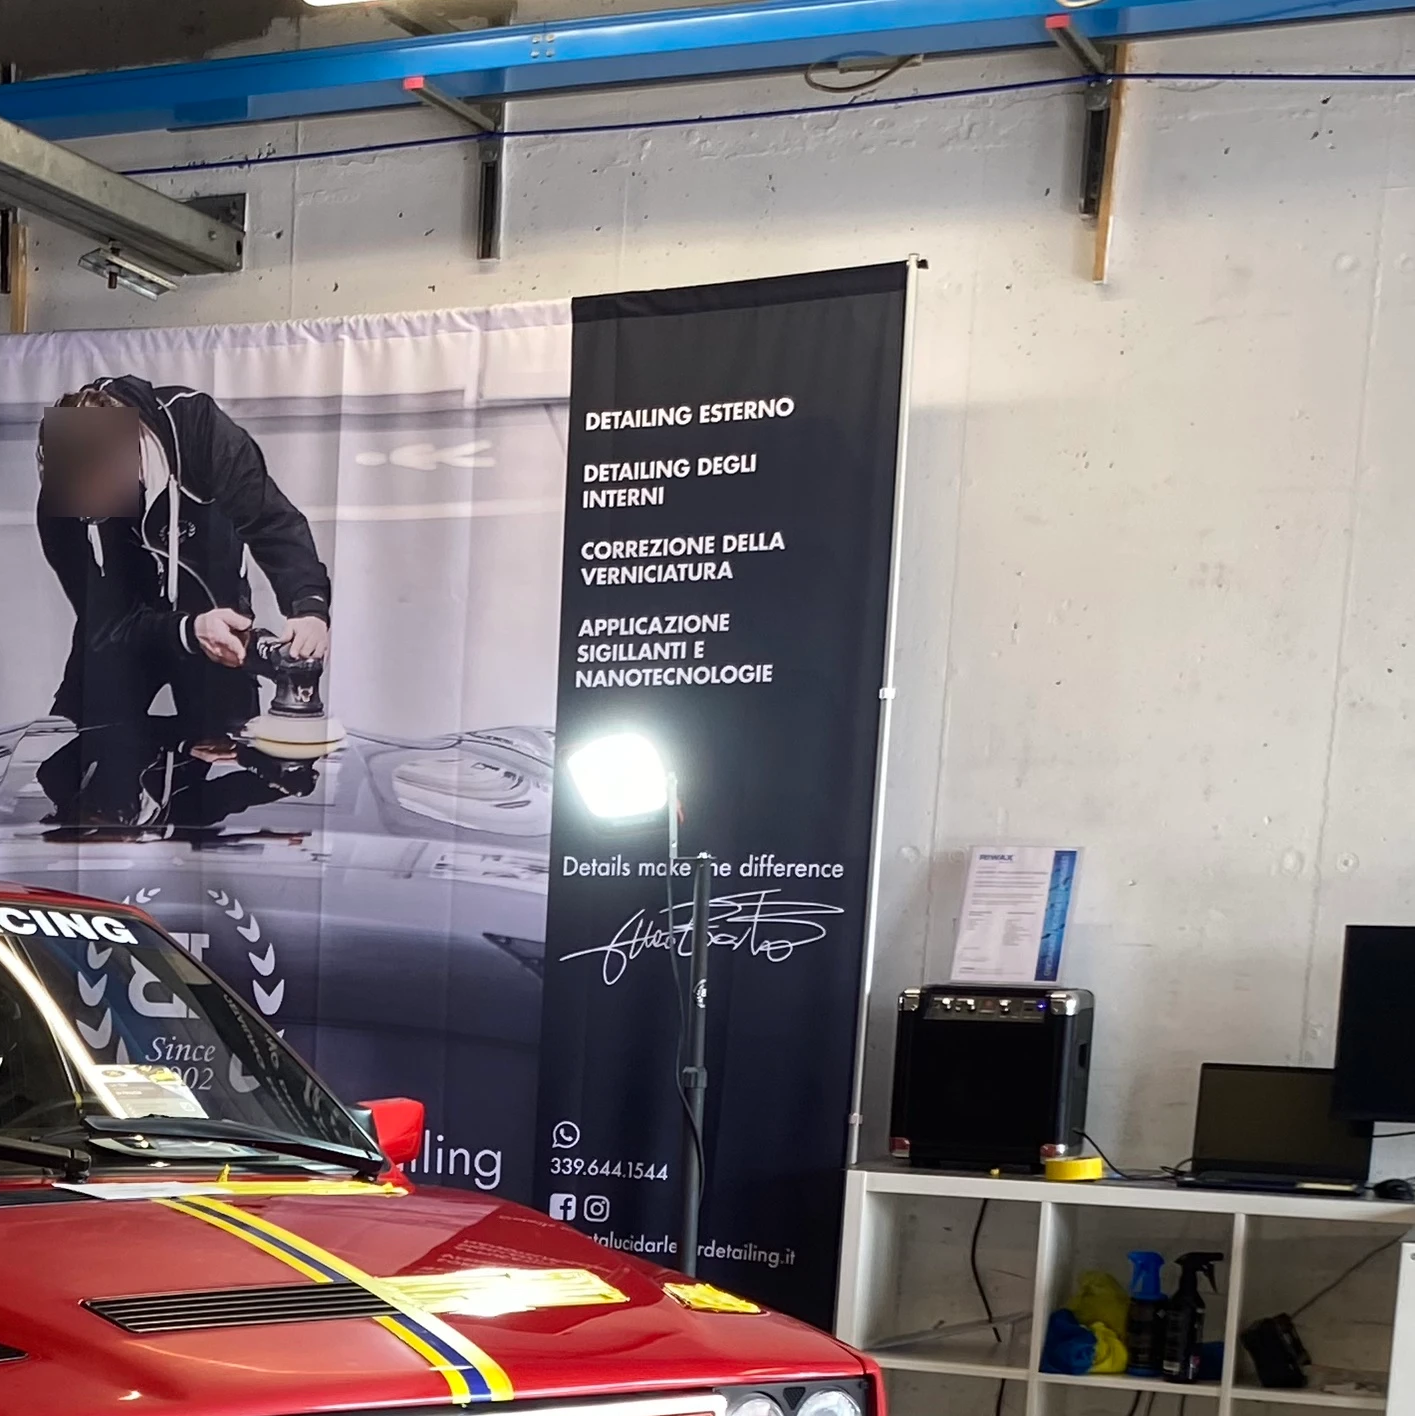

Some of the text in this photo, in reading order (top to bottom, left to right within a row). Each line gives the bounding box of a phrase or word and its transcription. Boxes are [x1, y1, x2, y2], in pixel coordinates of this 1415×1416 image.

[585, 397, 795, 431] DETAILING ESTERNO
[583, 454, 757, 483] DETAILING DEGLI
[582, 486, 665, 509] INTERNI
[581, 531, 785, 561] CORREZIONE DELLA
[580, 561, 733, 586] VERNICIATURA
[578, 613, 730, 637] APPLICAZIONE
[577, 641, 705, 663] SIGILLANTI E
[575, 664, 773, 688] NANOTECNOLOGIE
[563, 855, 631, 877] Details
[638, 857, 691, 877] make
[739, 855, 844, 879] difference
[145, 1036, 216, 1062] Since
[550, 1157, 669, 1180] 339.644.1544
